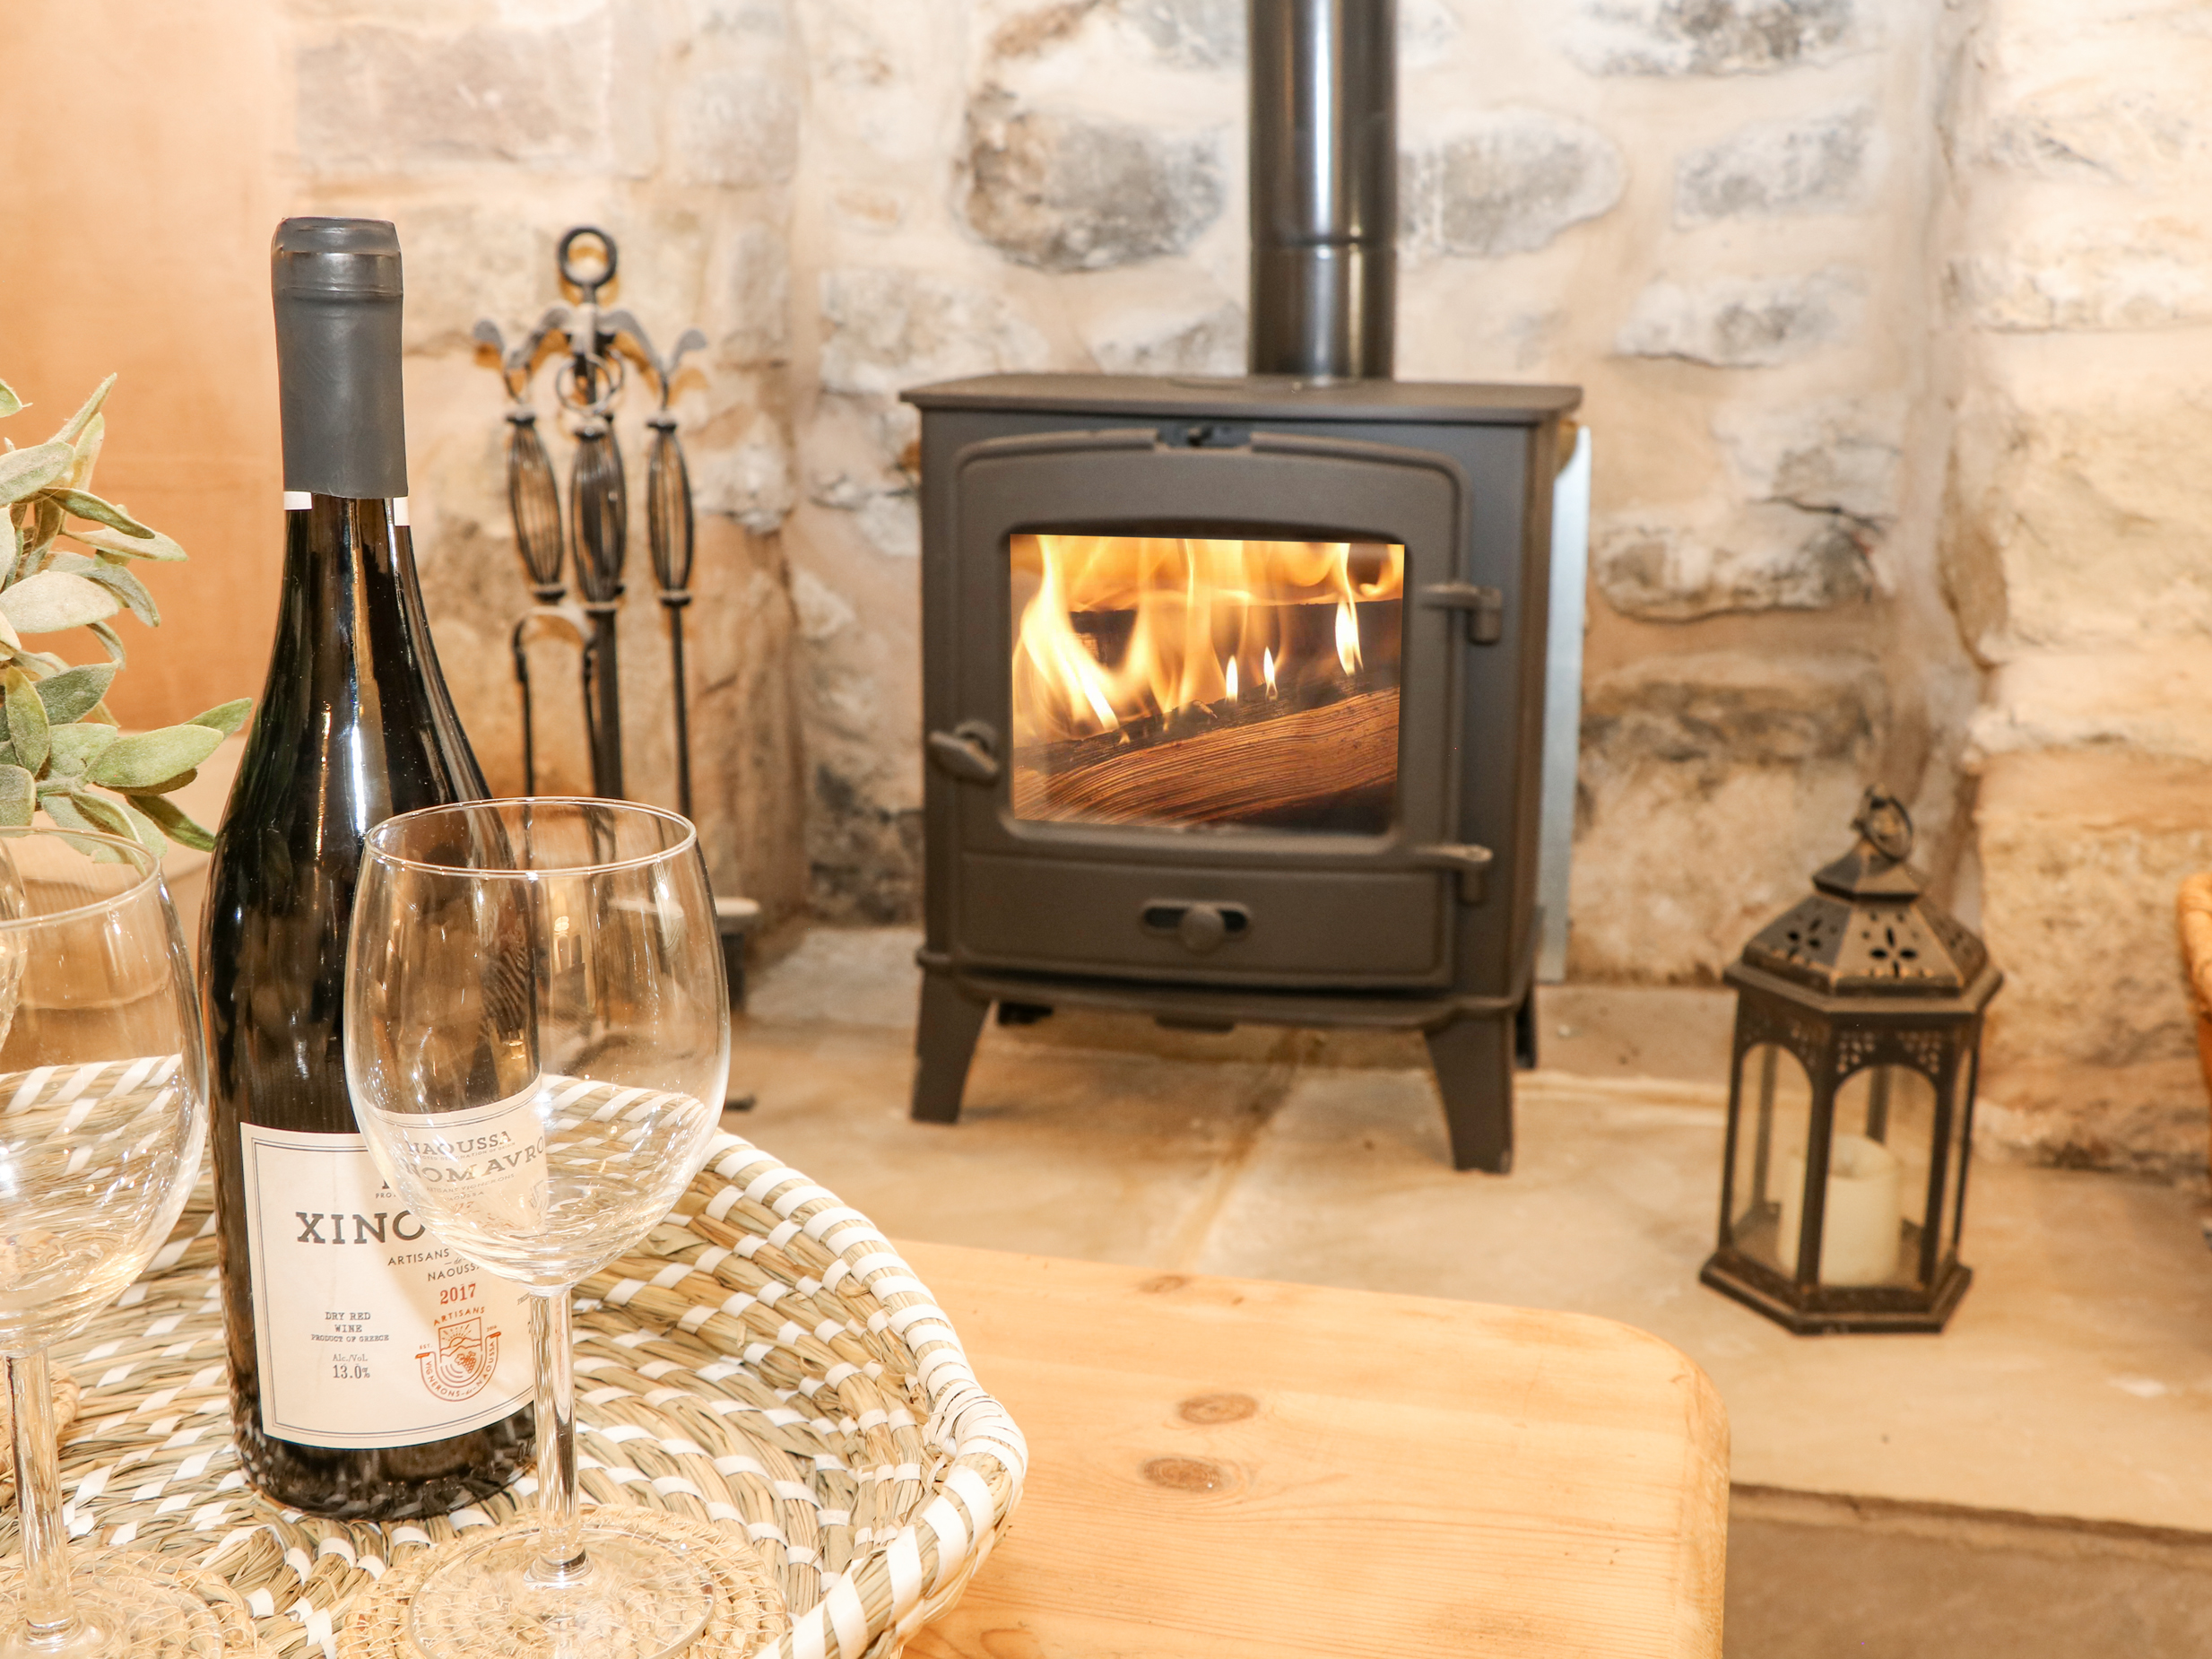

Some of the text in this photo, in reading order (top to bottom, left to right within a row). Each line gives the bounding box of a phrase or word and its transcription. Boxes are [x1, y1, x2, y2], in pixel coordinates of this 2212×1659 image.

[387, 1247, 449, 1266] ARTISANS
[439, 1282, 477, 1305] 2017
[325, 1311, 371, 1321] DRY RED
[433, 1307, 486, 1326] ARTISANS
[334, 1324, 362, 1333] WINE
[310, 1333, 343, 1342] PRODUCT
[359, 1334, 389, 1342] GREECE
[333, 1364, 370, 1379] 13.0%
